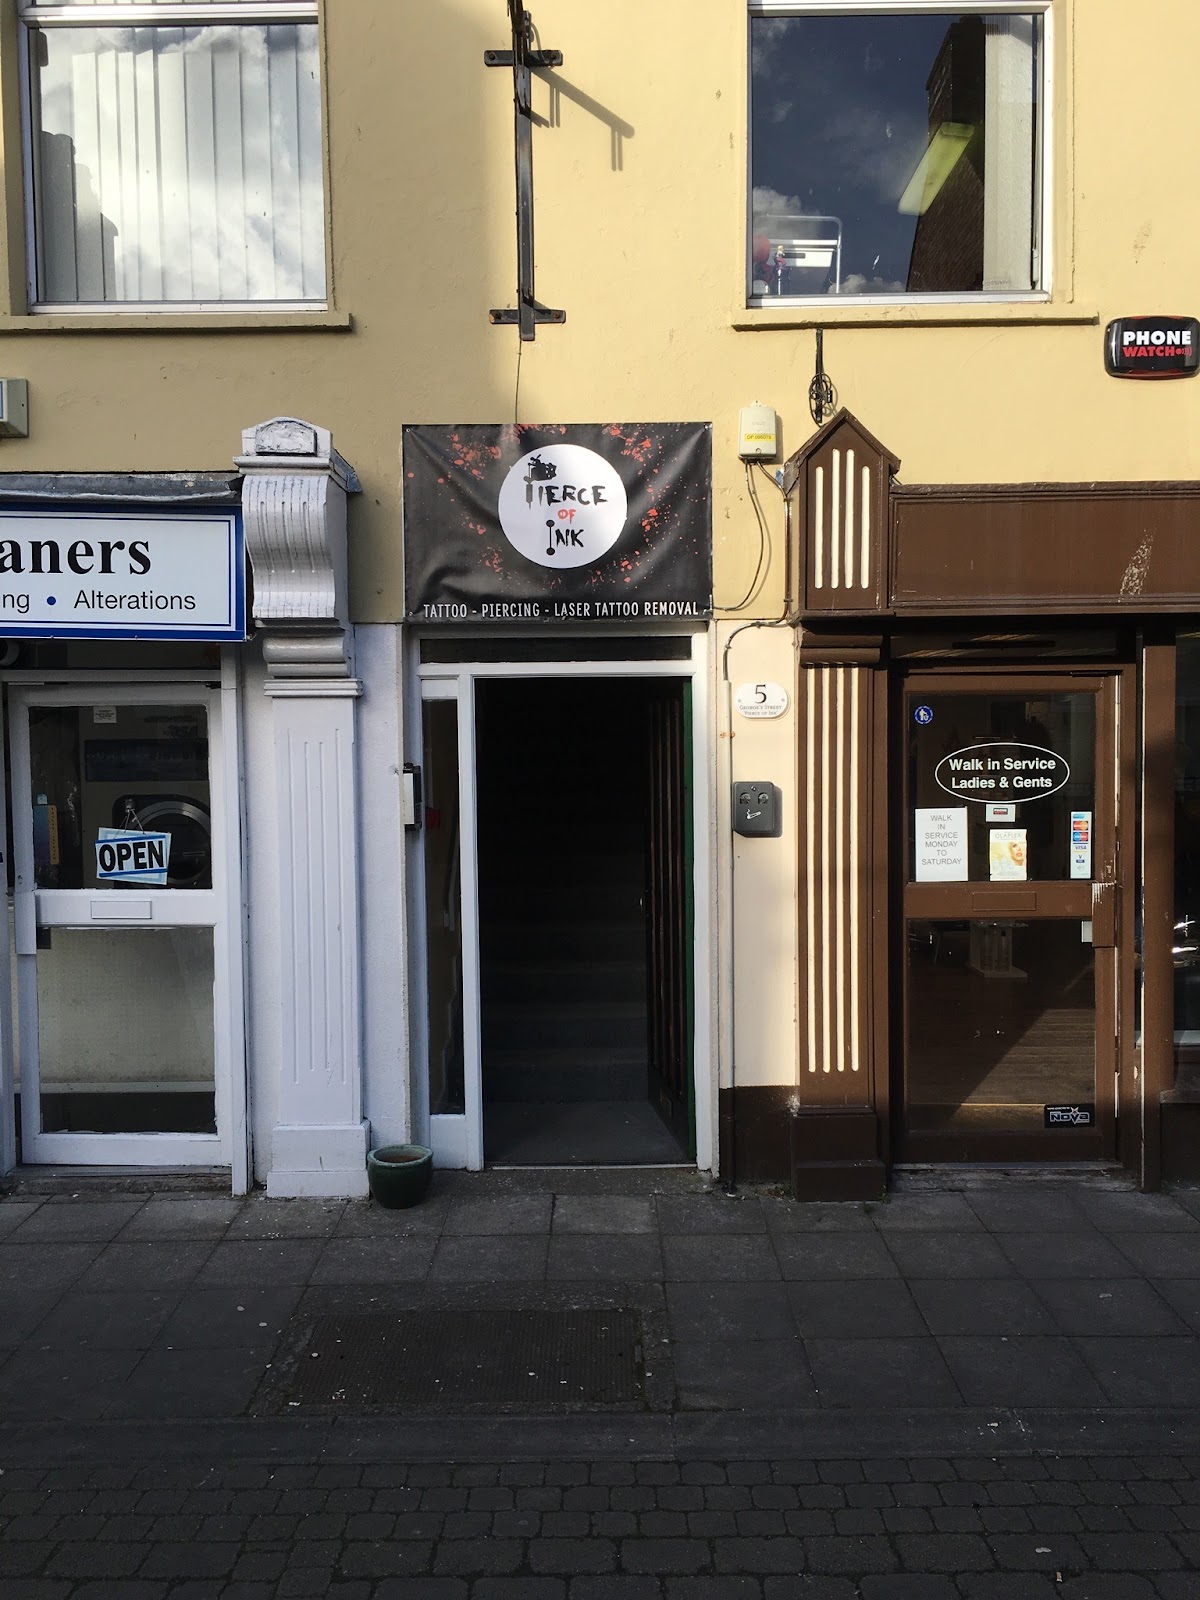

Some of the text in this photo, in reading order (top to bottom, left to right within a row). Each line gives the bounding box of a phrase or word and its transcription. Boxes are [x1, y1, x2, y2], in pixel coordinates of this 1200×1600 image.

[1123, 330, 1192, 346] PHONE
[1122, 346, 1175, 358] WATCH
[557, 508, 577, 524] OF
[546, 519, 585, 556] INK
[0, 539, 151, 575] aners
[2, 589, 197, 614] ng Alterations
[423, 603, 468, 618] TATTOO
[481, 602, 541, 617] PIERCING
[554, 601, 591, 617] LASER
[595, 601, 639, 616] TATTOO
[644, 601, 699, 616] REMOVAL
[754, 684, 767, 704] 5
[948, 757, 1057, 771] Walk in Service
[951, 776, 1053, 789] Ladies & Gents
[924, 831, 959, 840] SERVICE
[924, 840, 959, 848] MONDAY
[98, 840, 165, 873] OPEN
[936, 849, 948, 857] TO
[921, 858, 962, 866] SATURDAY
